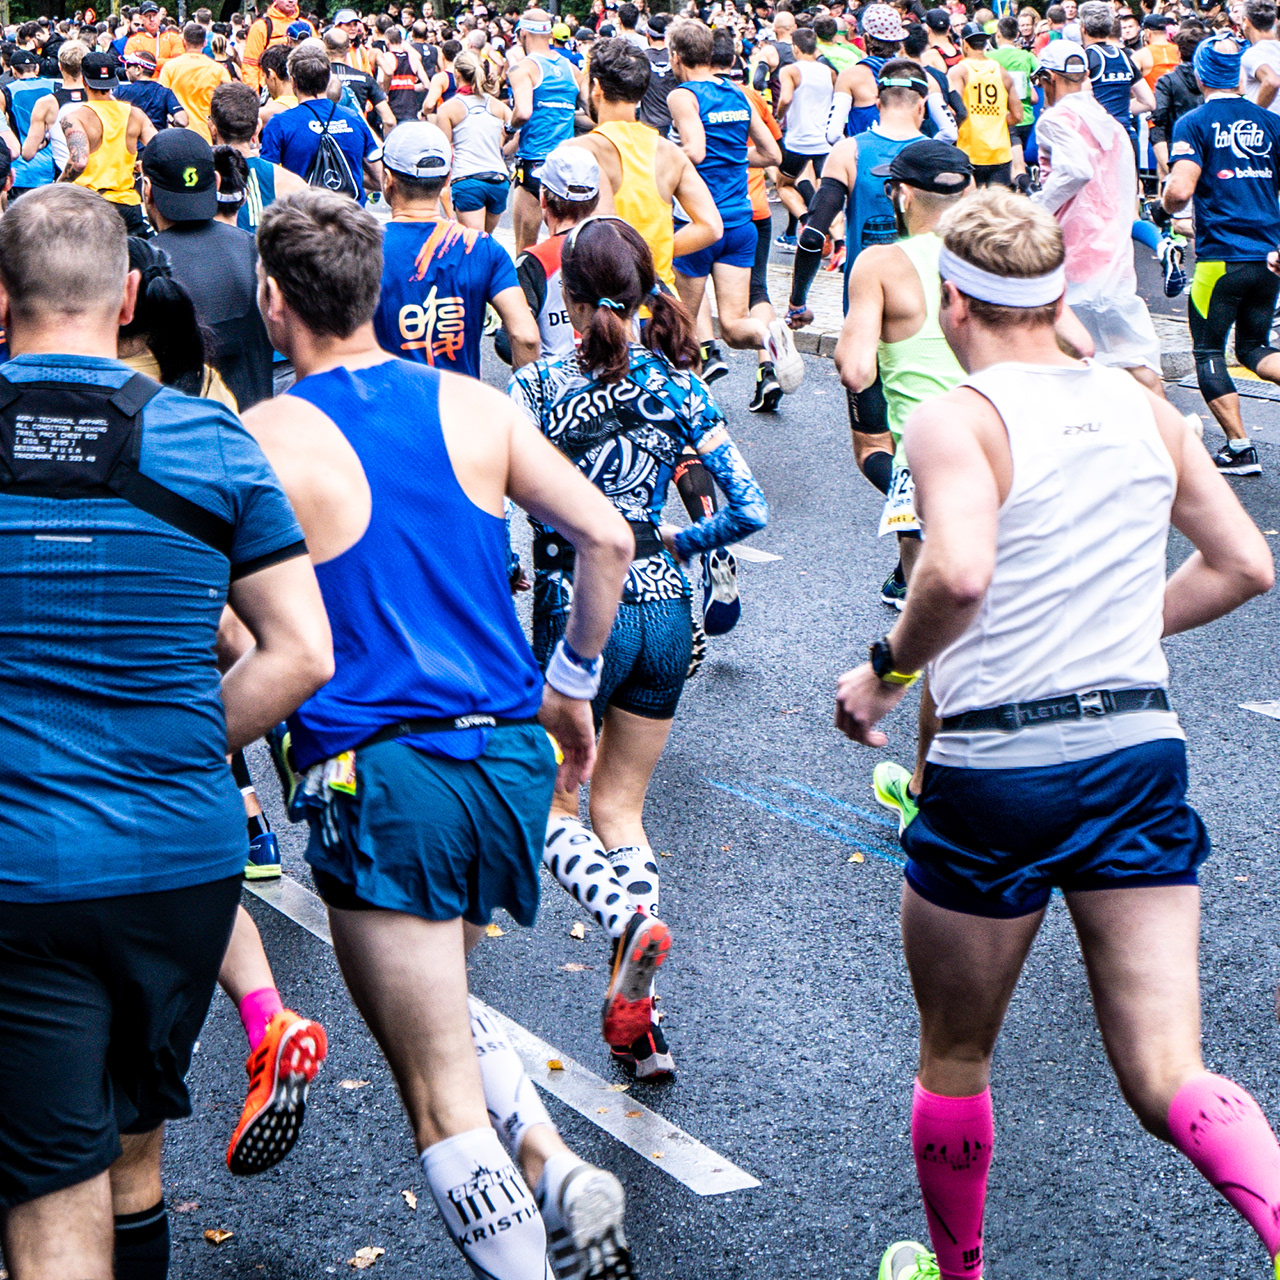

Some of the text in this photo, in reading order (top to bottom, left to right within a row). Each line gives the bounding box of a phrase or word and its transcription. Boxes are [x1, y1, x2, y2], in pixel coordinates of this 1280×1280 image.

[973, 83, 998, 105] 19
[708, 110, 750, 123] SVERIGE
[15, 422, 29, 430] ALL
[31, 423, 71, 432] CONDITION
[13, 445, 46, 453] DESIGNED
